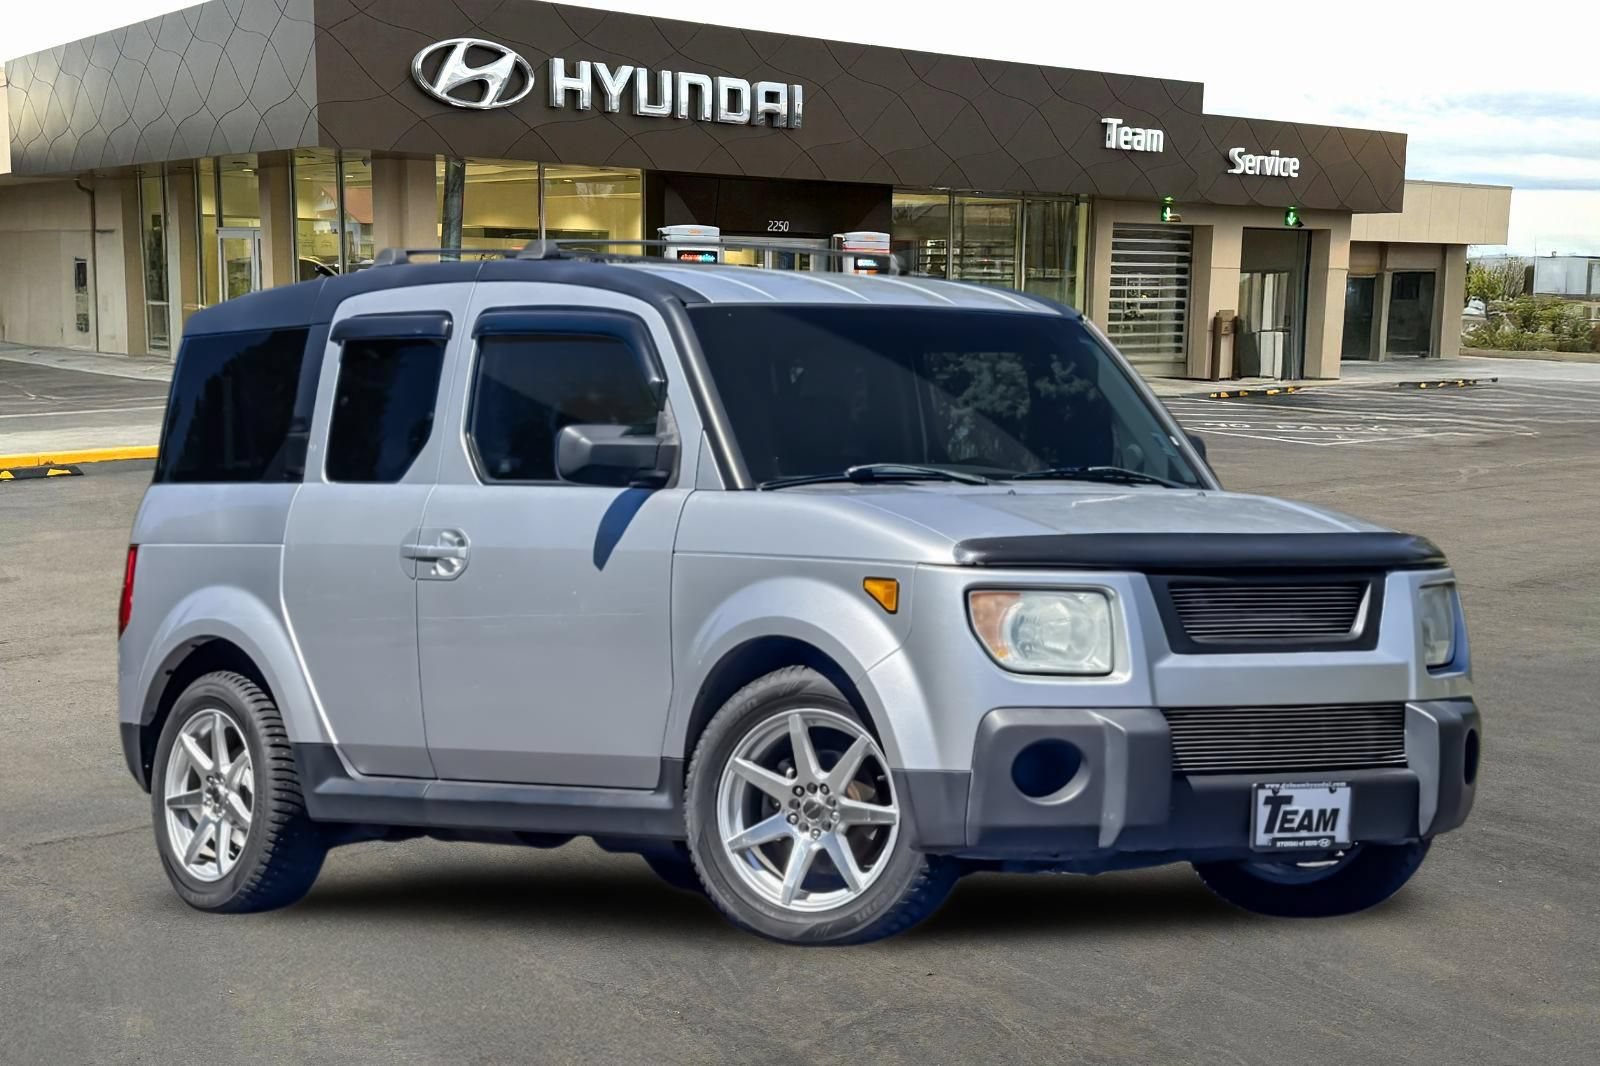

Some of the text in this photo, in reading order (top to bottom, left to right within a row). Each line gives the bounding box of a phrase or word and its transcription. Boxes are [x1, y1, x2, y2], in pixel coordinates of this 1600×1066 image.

[548, 57, 802, 129] HYUNDAI
[1101, 117, 1164, 153] Team
[1227, 147, 1300, 178] Service
[767, 220, 790, 232] 2250
[1263, 795, 1340, 834] TEAM
